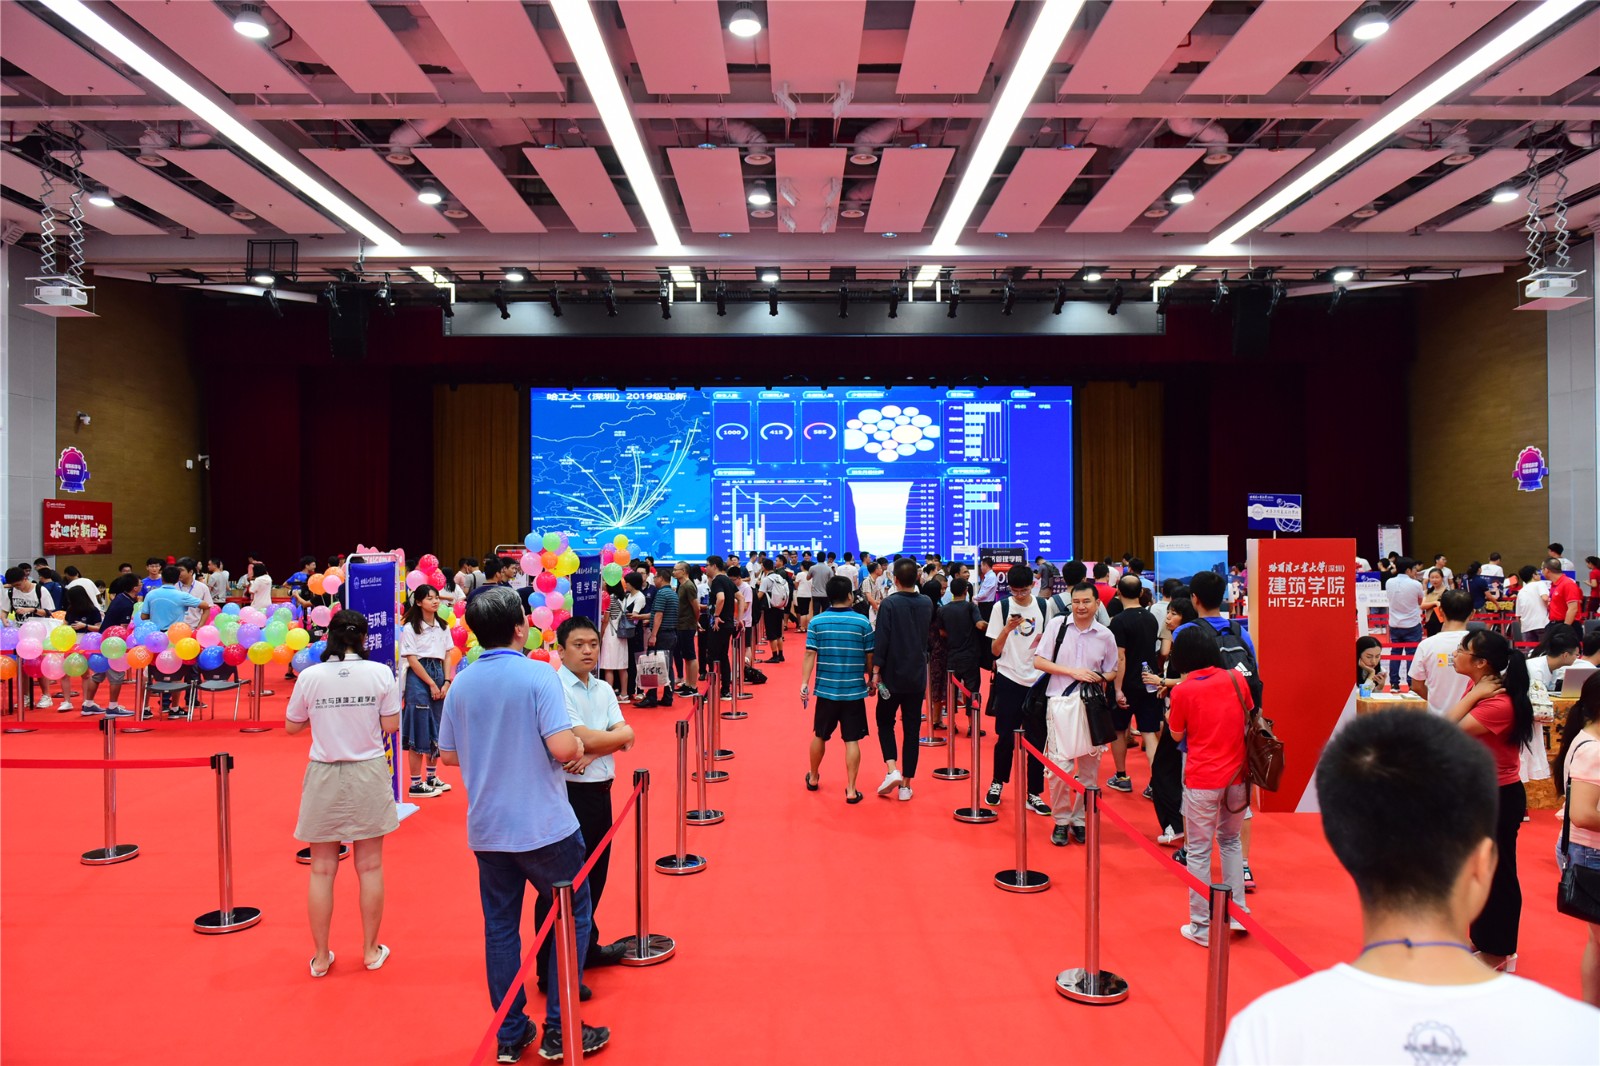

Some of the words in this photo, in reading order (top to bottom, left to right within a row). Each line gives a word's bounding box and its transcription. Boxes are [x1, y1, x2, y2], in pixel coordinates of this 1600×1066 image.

[1268, 576, 1345, 595] 建筑学院
[1268, 597, 1345, 608] HITSZ-ARCH
